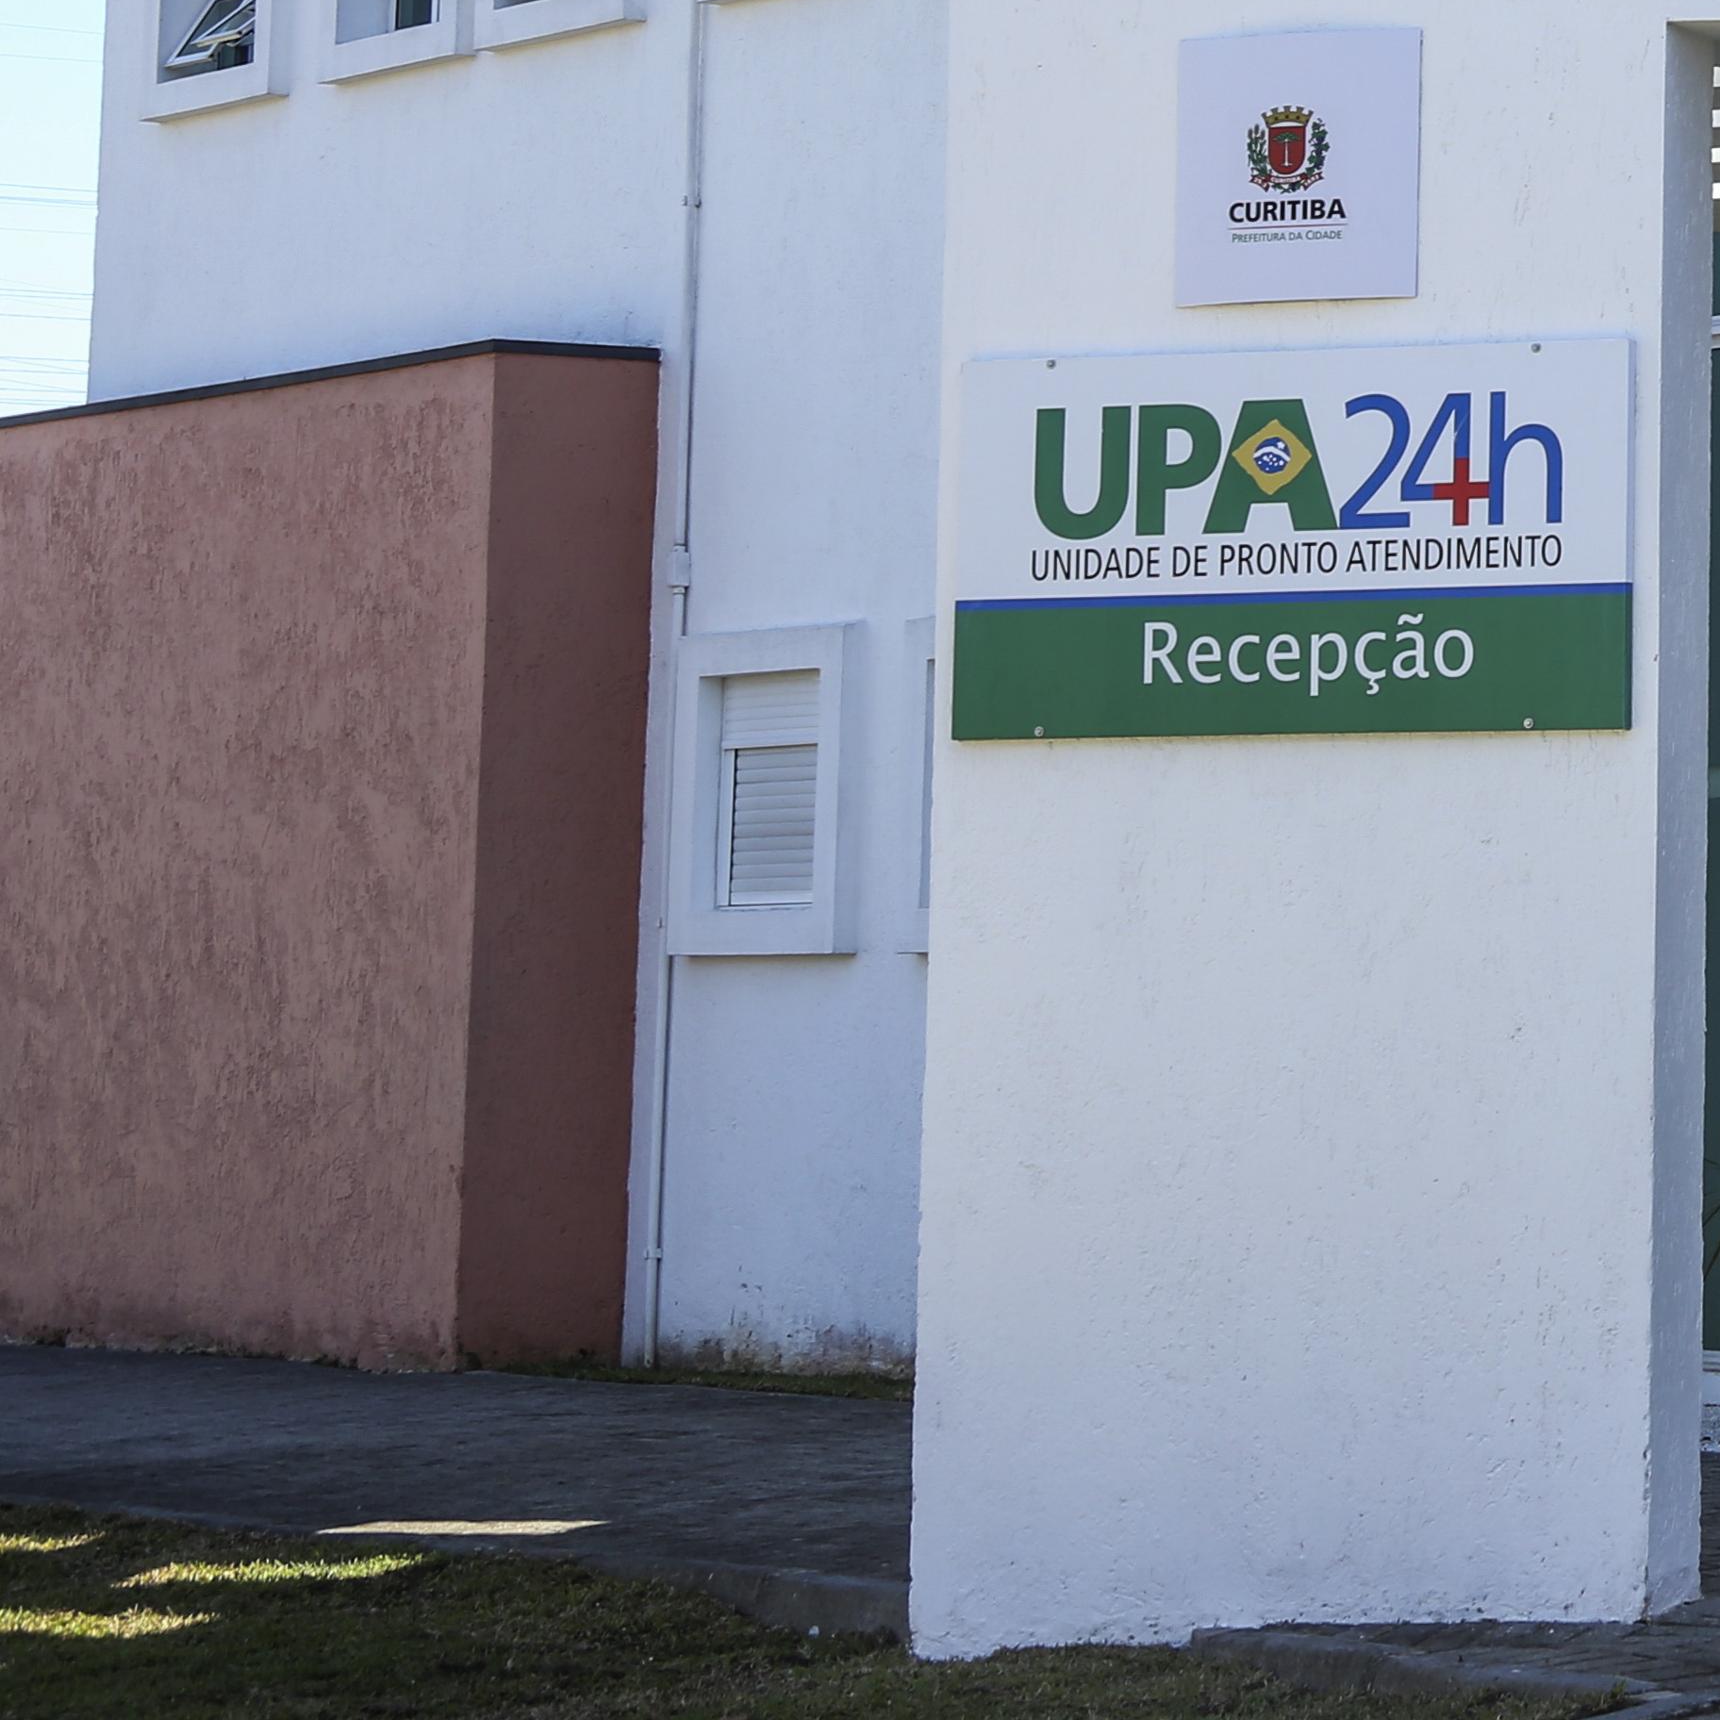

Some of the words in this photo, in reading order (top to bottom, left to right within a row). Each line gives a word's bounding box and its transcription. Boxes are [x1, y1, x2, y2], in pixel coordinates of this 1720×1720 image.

[1229, 198, 1346, 223] CURITIBA
[1231, 232, 1286, 243] PREFEITURA
[1288, 231, 1303, 241] DA
[1305, 230, 1343, 241] CIDADE
[1031, 546, 1161, 581] UNIDADE
[1172, 544, 1208, 578] DE
[1219, 540, 1338, 575] PRONTO
[1345, 534, 1563, 572] ATENDIMENTO
[1142, 613, 1475, 696] Recepção
